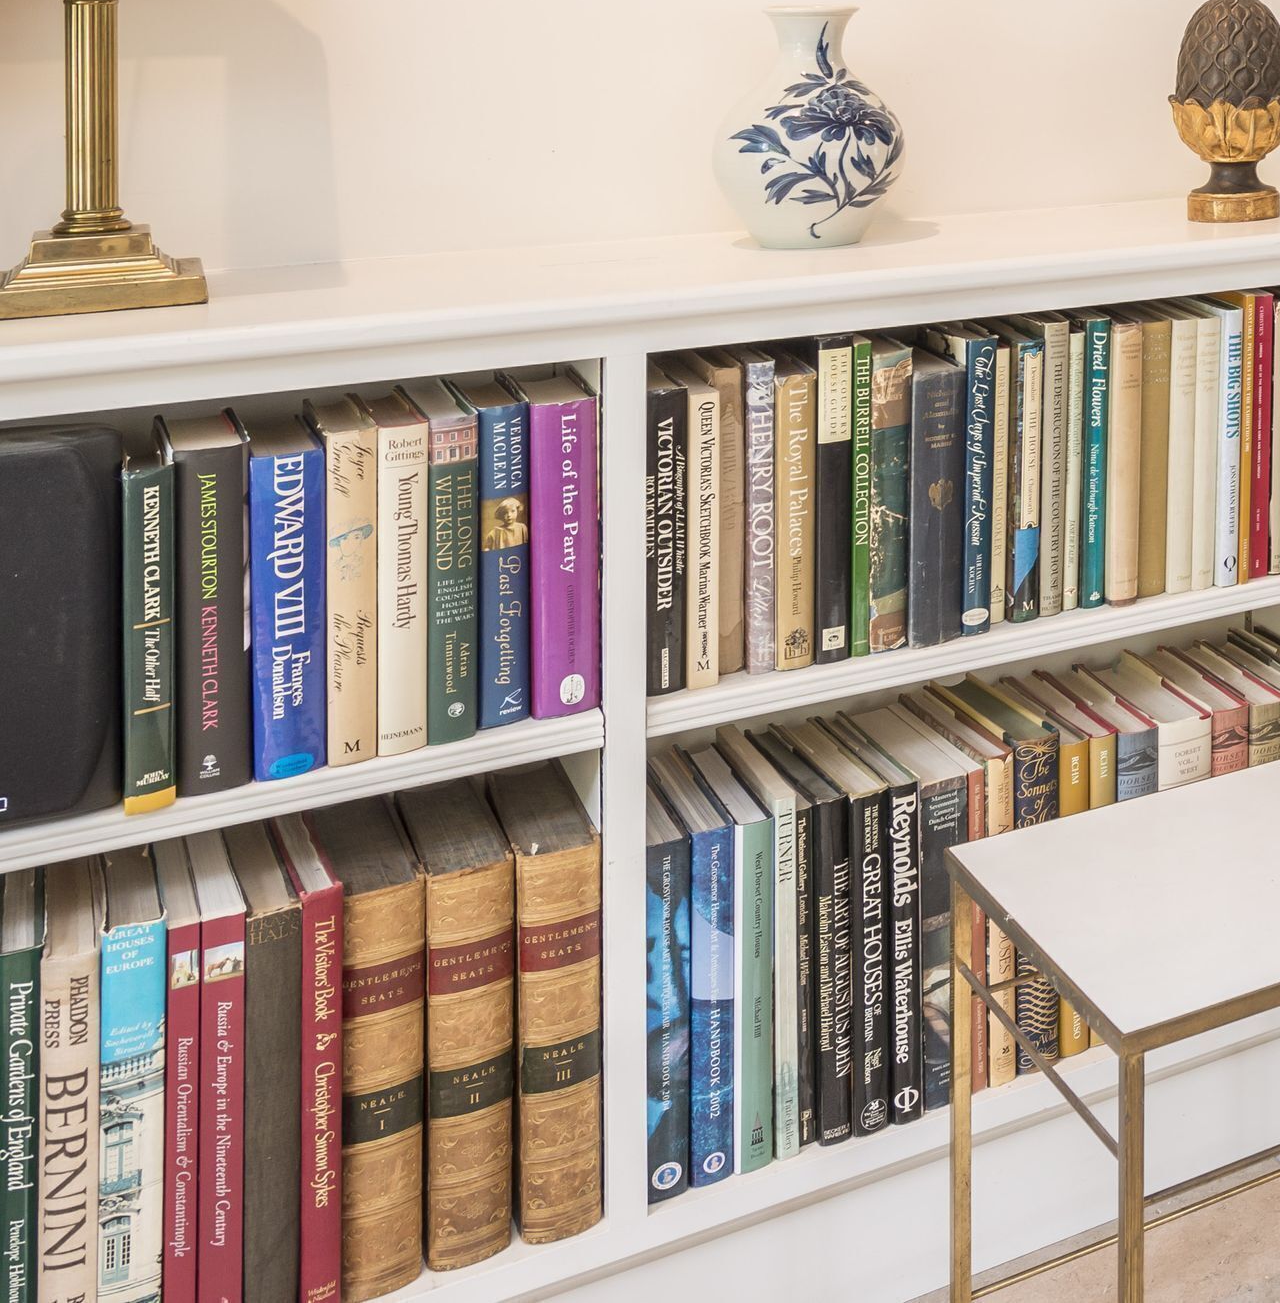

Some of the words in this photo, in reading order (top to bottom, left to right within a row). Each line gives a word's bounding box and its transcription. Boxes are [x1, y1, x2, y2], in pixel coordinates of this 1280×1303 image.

[1093, 331, 1107, 370] Dried
[1228, 333, 1241, 362] THE
[857, 355, 870, 384] THE
[1227, 365, 1240, 392] BIG
[699, 401, 715, 436] QUEEN
[790, 382, 808, 423] The
[856, 389, 870, 450] BURRELL
[1092, 377, 1106, 427] Flowers
[1226, 394, 1240, 439] SHOTS
[388, 437, 422, 451] Robert
[561, 413, 576, 453] Life
[384, 449, 424, 464] Gittings
[493, 422, 506, 489] MACLEAN
[510, 417, 522, 489] VERONICA
[563, 459, 577, 479] of
[657, 417, 673, 515] VICTORIAN
[700, 437, 715, 491] VICTORIA'S
[784, 427, 808, 482] Royal
[197, 473, 217, 518] JAMES
[393, 472, 418, 520] Young
[457, 471, 471, 511] THE
[562, 484, 577, 515] the
[855, 453, 870, 545] COLLECTION
[143, 485, 160, 564] KENNETH
[267, 453, 305, 578] EDWARD
[435, 475, 453, 570] WEEKEND
[699, 494, 715, 559] SKETCHBOOK
[790, 487, 808, 556] Palaces
[200, 520, 217, 600] STOURTON
[397, 519, 418, 582] Thomas
[457, 516, 472, 568] LONG
[560, 520, 578, 572] Party
[657, 519, 673, 611] OUTSIDER
[699, 562, 711, 595] Marina
[968, 566, 976, 593] KOCHAN
[975, 553, 983, 580] MIRIAM
[143, 565, 160, 621] CLARK
[274, 578, 305, 639] VIII
[392, 583, 417, 629] Hardy
[699, 596, 711, 629] Warner
[1022, 600, 1035, 611] M
[144, 628, 160, 649] The
[201, 606, 218, 677] KENNETH
[144, 649, 160, 678] Other
[292, 650, 311, 707] Frances
[445, 630, 457, 693] Tinniswood
[460, 642, 469, 677] Adrian
[143, 679, 160, 702] Half
[272, 644, 293, 719] Donaldson
[201, 679, 218, 731] CLARK
[500, 704, 522, 715] review
[344, 739, 360, 754] M
[381, 726, 423, 740] HEINEMANN
[136, 771, 170, 787] MURRAY
[144, 769, 163, 780] JOHN
[1020, 753, 1056, 782] The
[1071, 755, 1080, 785] RCHM
[1100, 749, 1108, 778] RCHM
[1017, 780, 1058, 798] Sonnets
[779, 809, 792, 882] TURNER
[934, 821, 955, 832] Painting
[755, 851, 763, 869] West
[890, 792, 917, 907] Reynolds
[755, 871, 763, 897] Dorset
[834, 857, 849, 895] THE
[862, 853, 881, 925] GREAT
[315, 915, 335, 943] The
[754, 898, 764, 929] Country
[834, 898, 850, 927] ART
[106, 935, 154, 953] HOUSES
[541, 943, 581, 959] SEATS
[755, 931, 763, 958] Houses
[834, 933, 850, 948] OF
[895, 917, 912, 960] Ellis
[105, 957, 154, 975] EUROPE
[315, 941, 336, 987] Visitors'
[452, 964, 494, 982] SEATS
[863, 927, 882, 1004] HOUSES
[9, 980, 34, 1036] Private
[68, 975, 89, 1046] PHAIDON
[315, 987, 336, 1022] Book
[361, 987, 405, 1005] SEATS
[834, 954, 850, 1034] AUGUSTUS
[874, 1004, 881, 1015] OF
[895, 958, 912, 1064] Waterhouse
[44, 998, 60, 1049] PRESS
[217, 1001, 233, 1037] Russia
[864, 1008, 873, 1041] BRITAIN
[177, 1037, 193, 1080] Russian
[217, 1040, 234, 1052] &
[543, 1042, 584, 1060] NEALE
[710, 1007, 721, 1086] HANDBOOK
[835, 1037, 851, 1078] JOHN
[9, 1039, 35, 1106] Gardens
[212, 1056, 232, 1095] Europe
[453, 1065, 496, 1084] NEALE
[556, 1068, 572, 1082] III
[864, 1052, 873, 1084] Nicolson
[0, 1109, 35, 1122] of
[216, 1098, 231, 1110] in
[311, 1062, 335, 1130] Christopher
[710, 1091, 721, 1118] 2002
[177, 1084, 193, 1152] Orientalism
[216, 1114, 231, 1130] the
[0, 1123, 34, 1191] England
[177, 1156, 193, 1168] &
[215, 1135, 232, 1196] Nineteenth
[315, 1130, 335, 1169] Simon
[43, 1067, 88, 1272] BERNINI
[311, 1170, 336, 1208] Sykes
[170, 1171, 191, 1257] Constantinople
[210, 1200, 231, 1246] Century
